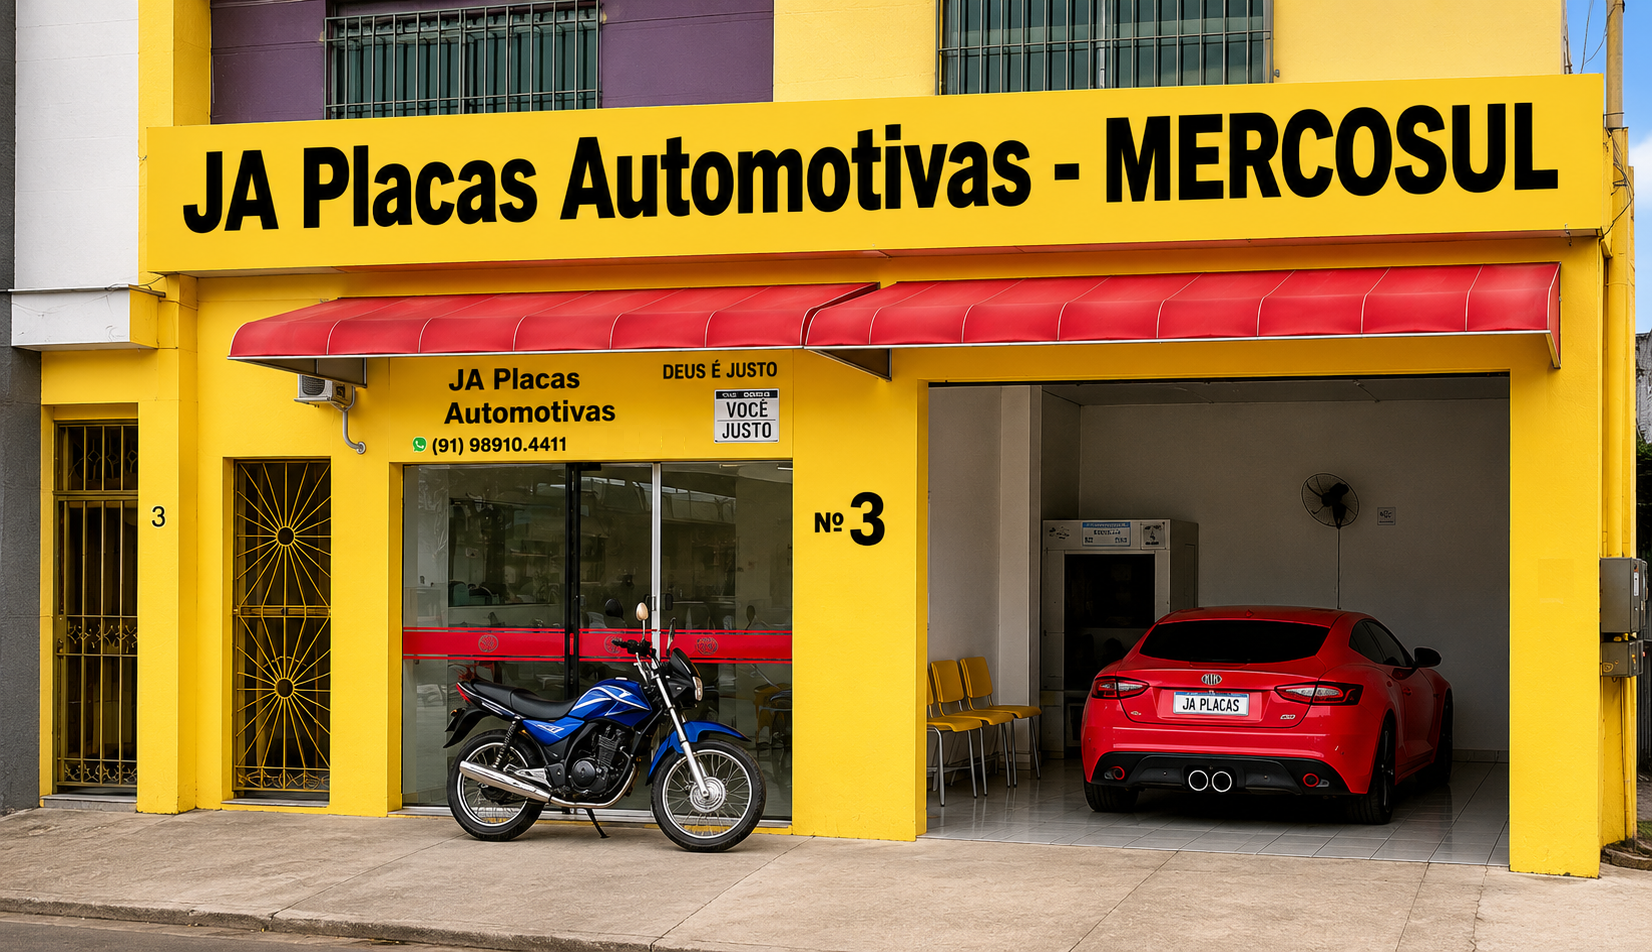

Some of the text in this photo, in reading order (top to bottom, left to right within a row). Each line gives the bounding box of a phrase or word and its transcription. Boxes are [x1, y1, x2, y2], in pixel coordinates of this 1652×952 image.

[182, 149, 279, 234] JA
[303, 144, 538, 229] Placas
[560, 123, 1032, 220] Automotivas
[1106, 102, 1559, 203] MERCOSUL
[448, 367, 580, 392] JA Placas
[662, 359, 778, 380] DEUS É JUSTO
[444, 399, 616, 425] Automotivas
[722, 422, 772, 439] JUSTO
[432, 436, 566, 456] (91) 98910.4411
[151, 505, 166, 528] 3
[849, 491, 886, 547] 3
[1182, 697, 1240, 712] JA PLACAS
